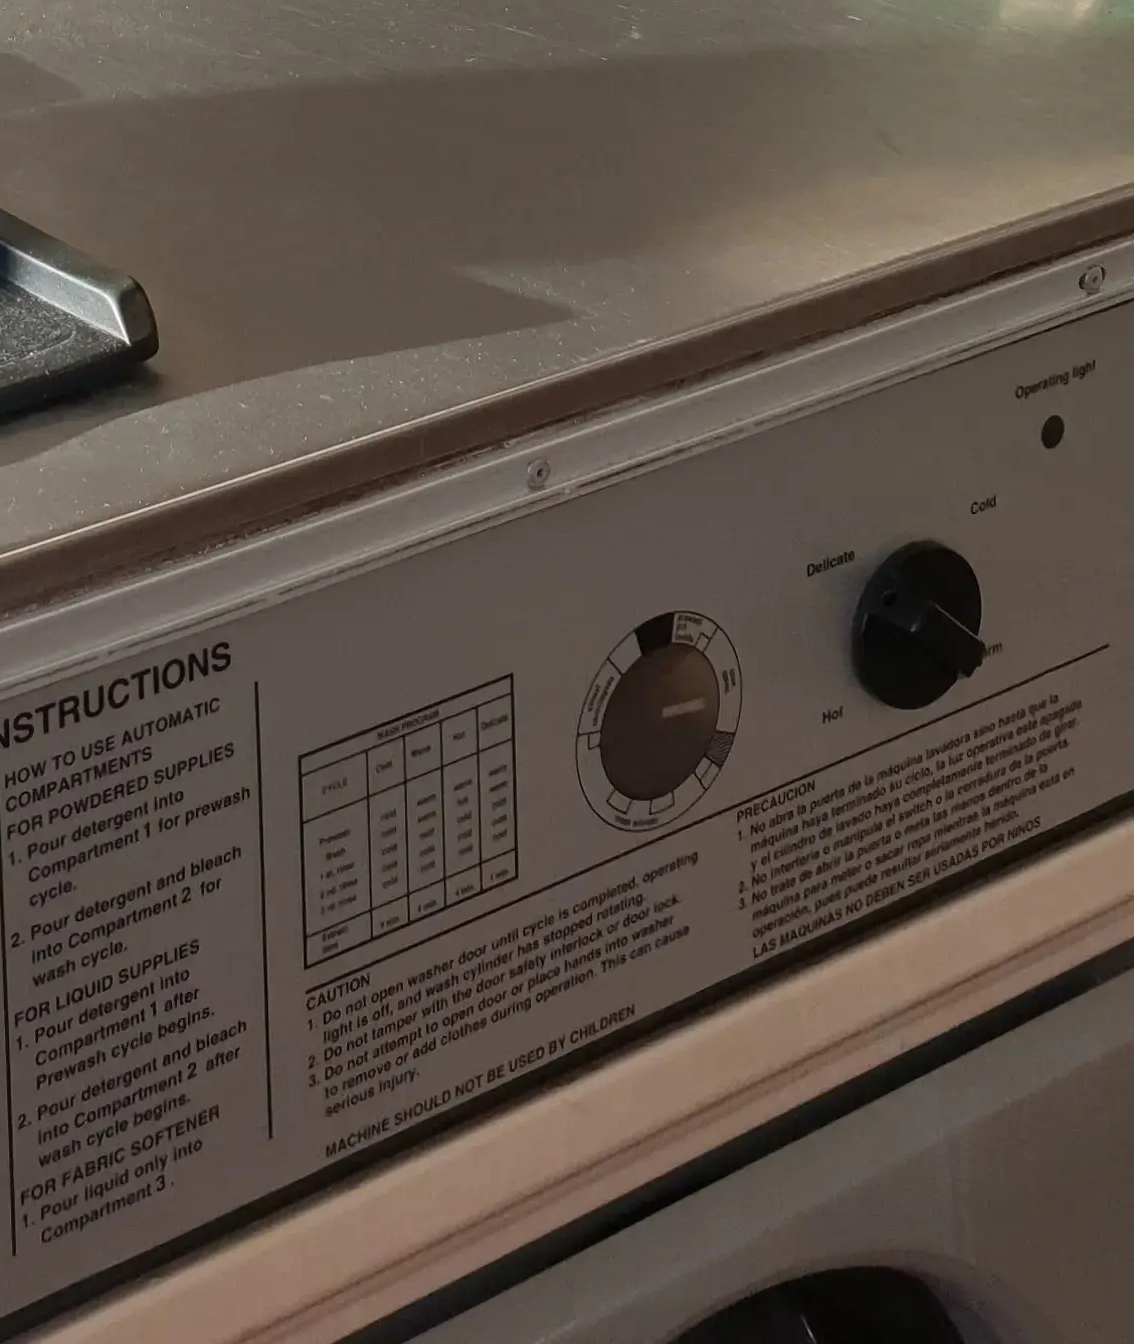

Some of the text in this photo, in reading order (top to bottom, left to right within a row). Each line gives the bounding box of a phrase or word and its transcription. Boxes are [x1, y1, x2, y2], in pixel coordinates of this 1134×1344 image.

[1013, 358, 1097, 401] Operating light
[969, 494, 997, 516] Cold
[805, 549, 856, 578] Delicate
[3, 696, 221, 791] HOW TO USE AUTOMATIC
[821, 705, 844, 725] Hot
[4, 745, 153, 814] COMPARTMENTS
[6, 741, 236, 842] FOR POWDERED SUPPLIES
[7, 789, 185, 867] 1. Pour detergent into
[27, 827, 140, 884] Compartment
[157, 813, 182, 834] for
[184, 785, 251, 828] prewash
[9, 845, 243, 950] 2. Pour detergent and bleach
[28, 879, 78, 909] cycle.
[31, 877, 223, 966] into Compartment 2 for
[13, 938, 201, 1030] FOR LIQUID SUPPLIES
[31, 940, 129, 988] wash cycle.
[305, 971, 371, 1012] CAUTION
[324, 1003, 636, 1159] MACHINE SHOULD NOT BE USED BY CHILDREN
[19, 1103, 221, 1207] FOR FABRIC SOFTENER
